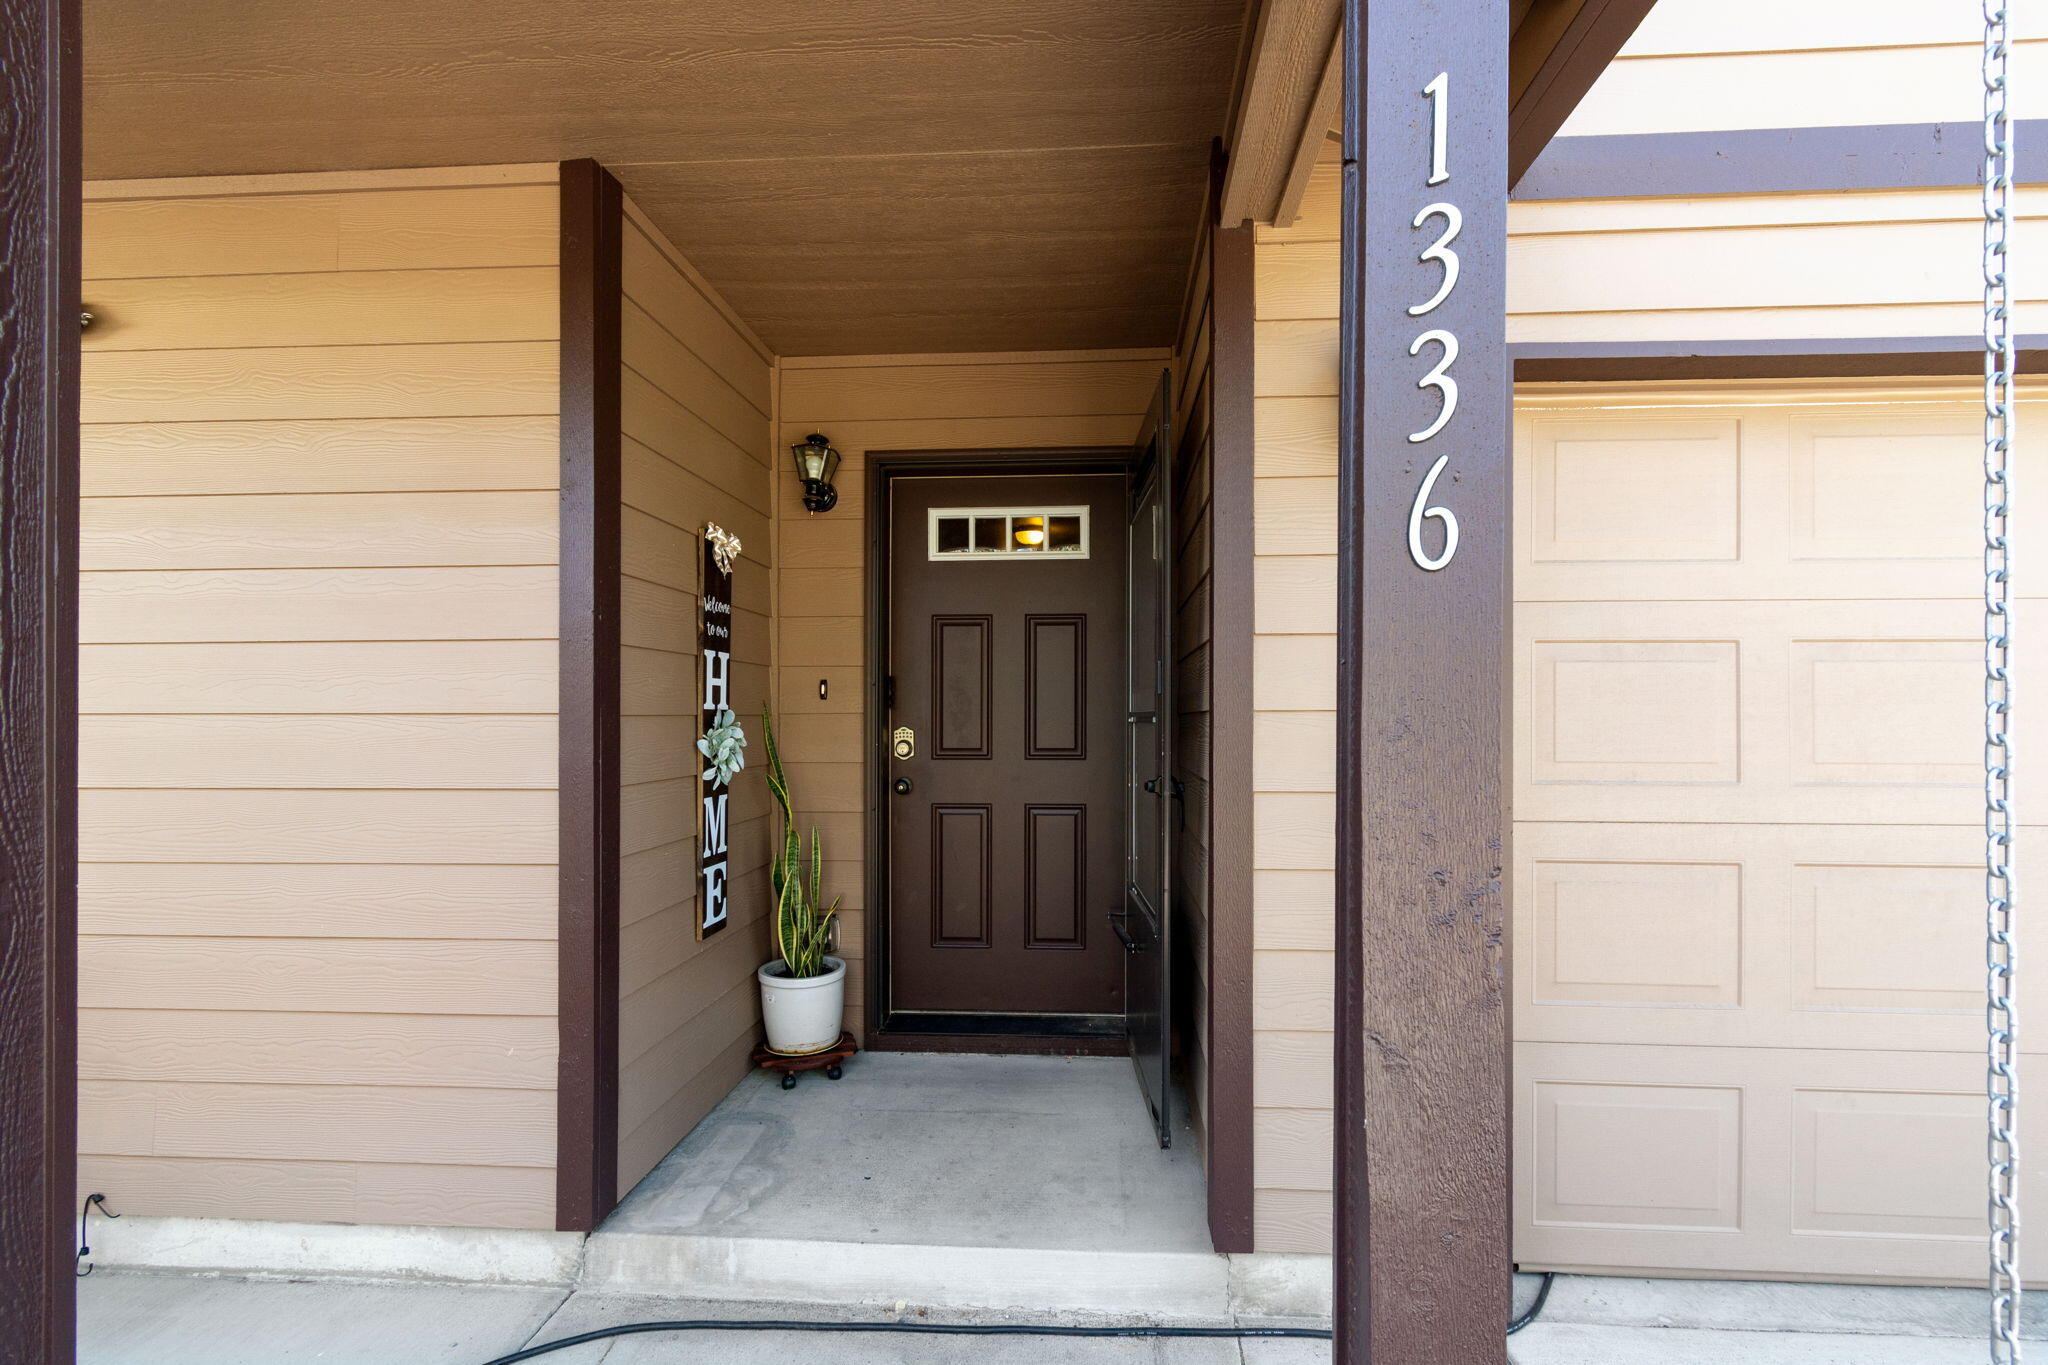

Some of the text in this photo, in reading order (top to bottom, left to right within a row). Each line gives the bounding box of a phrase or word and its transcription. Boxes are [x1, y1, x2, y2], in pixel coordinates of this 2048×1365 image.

[1408, 71, 1463, 570] 1336
[703, 594, 731, 615] Welcome
[706, 621, 729, 638] to our
